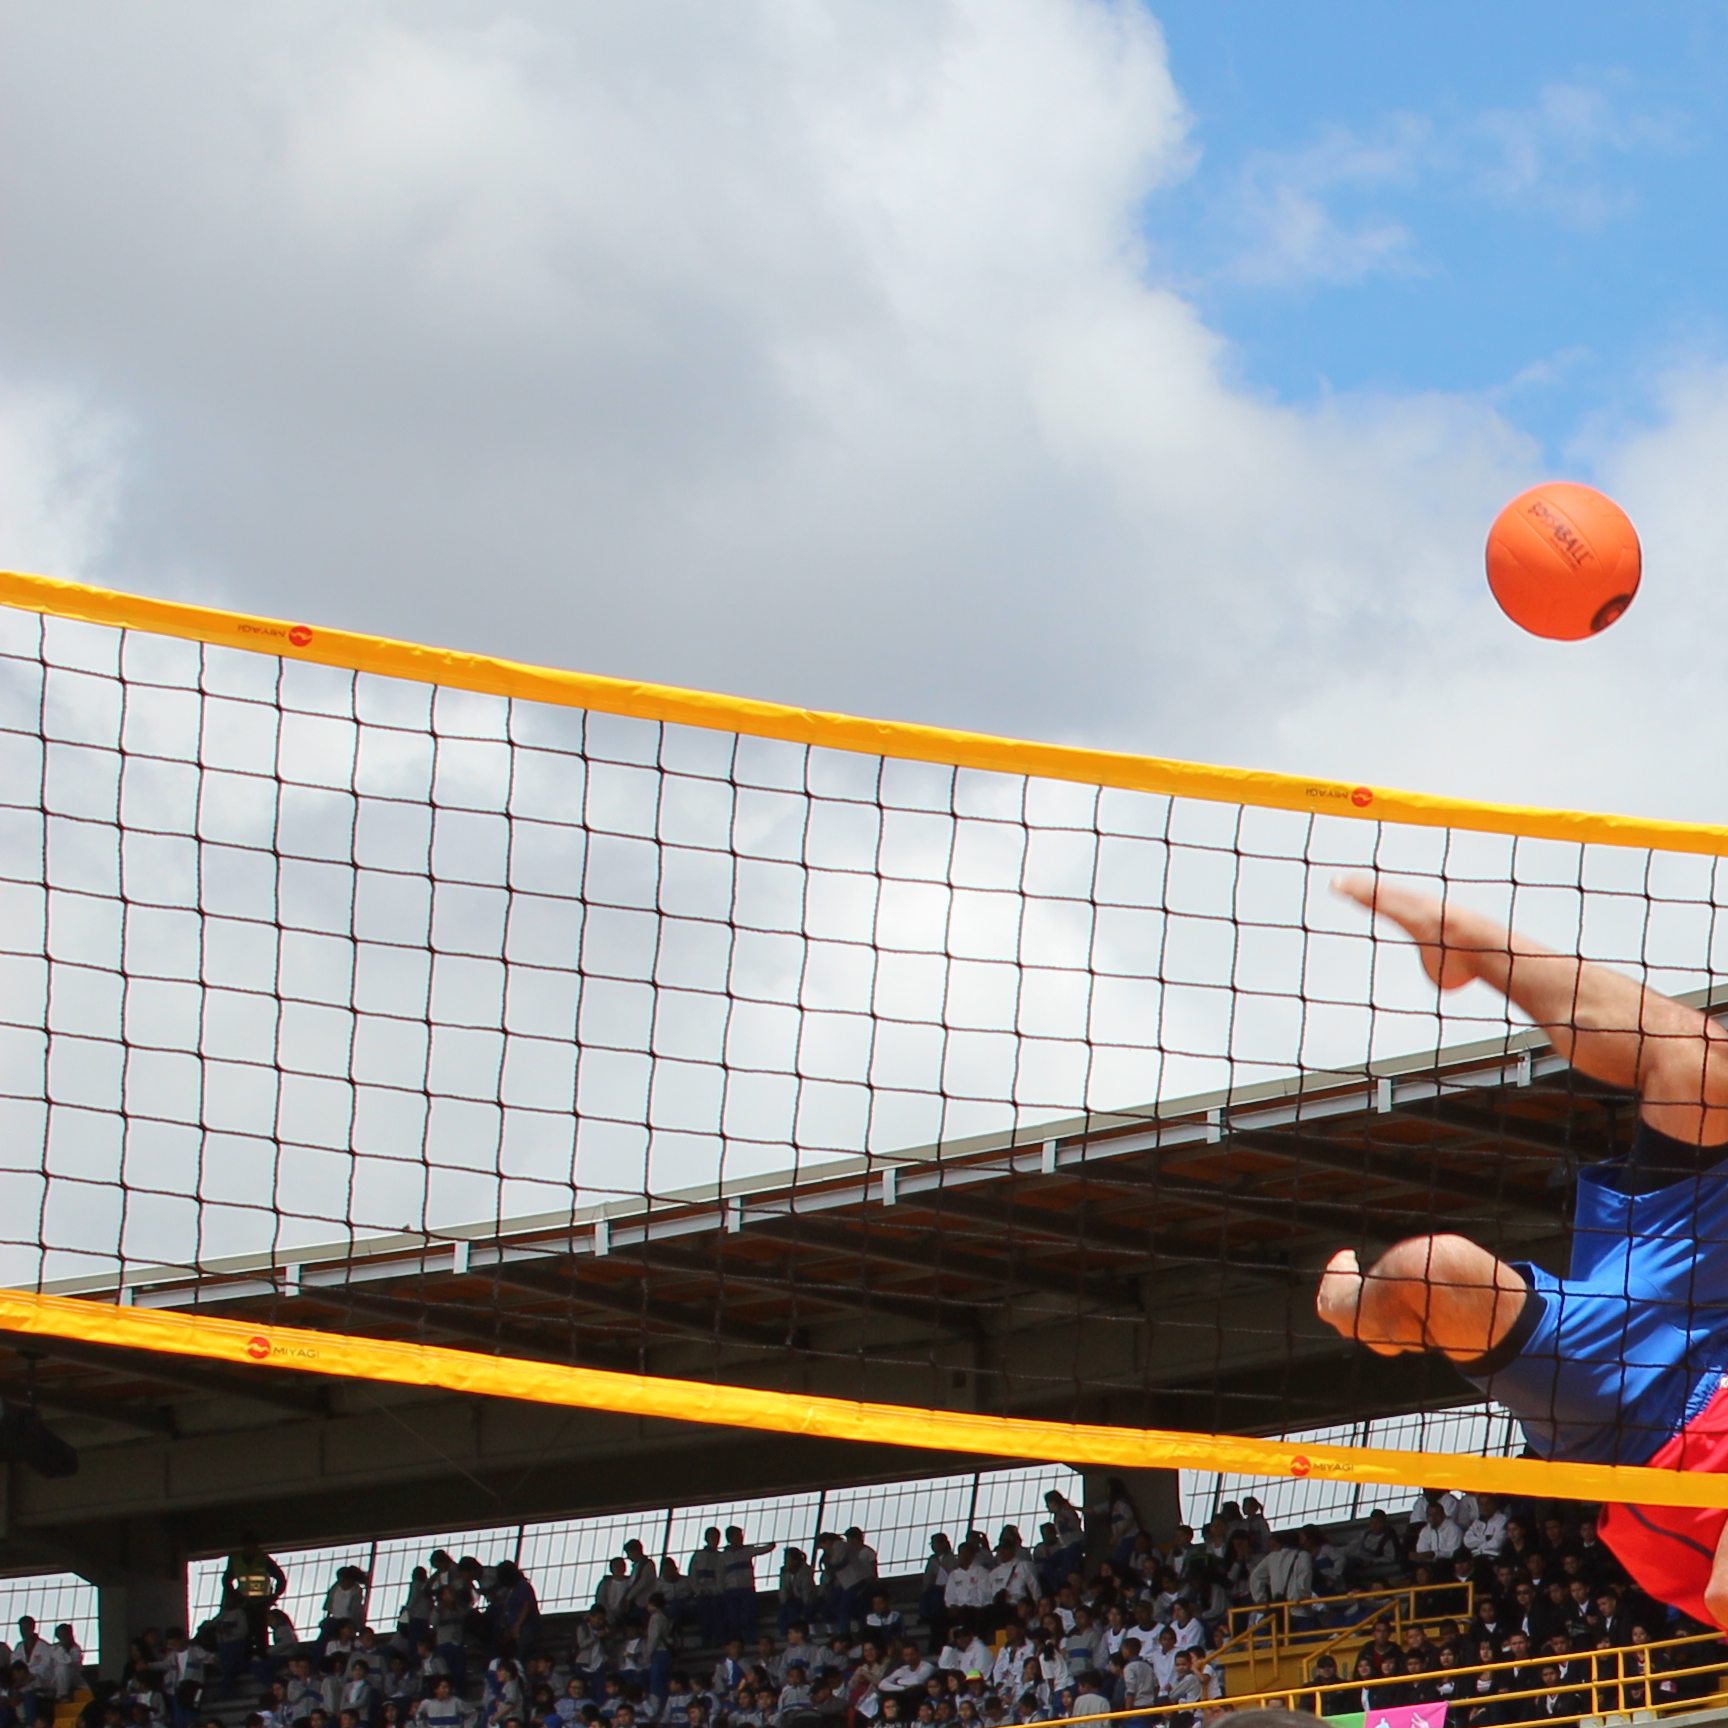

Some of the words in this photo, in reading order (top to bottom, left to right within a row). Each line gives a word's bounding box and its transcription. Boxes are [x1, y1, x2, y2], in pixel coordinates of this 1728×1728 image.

[237, 623, 286, 638] MIYAGI
[1305, 788, 1349, 800] MIYAGI
[273, 1346, 320, 1360] MIYAGI
[1313, 1463, 1354, 1472] MIYAGI
